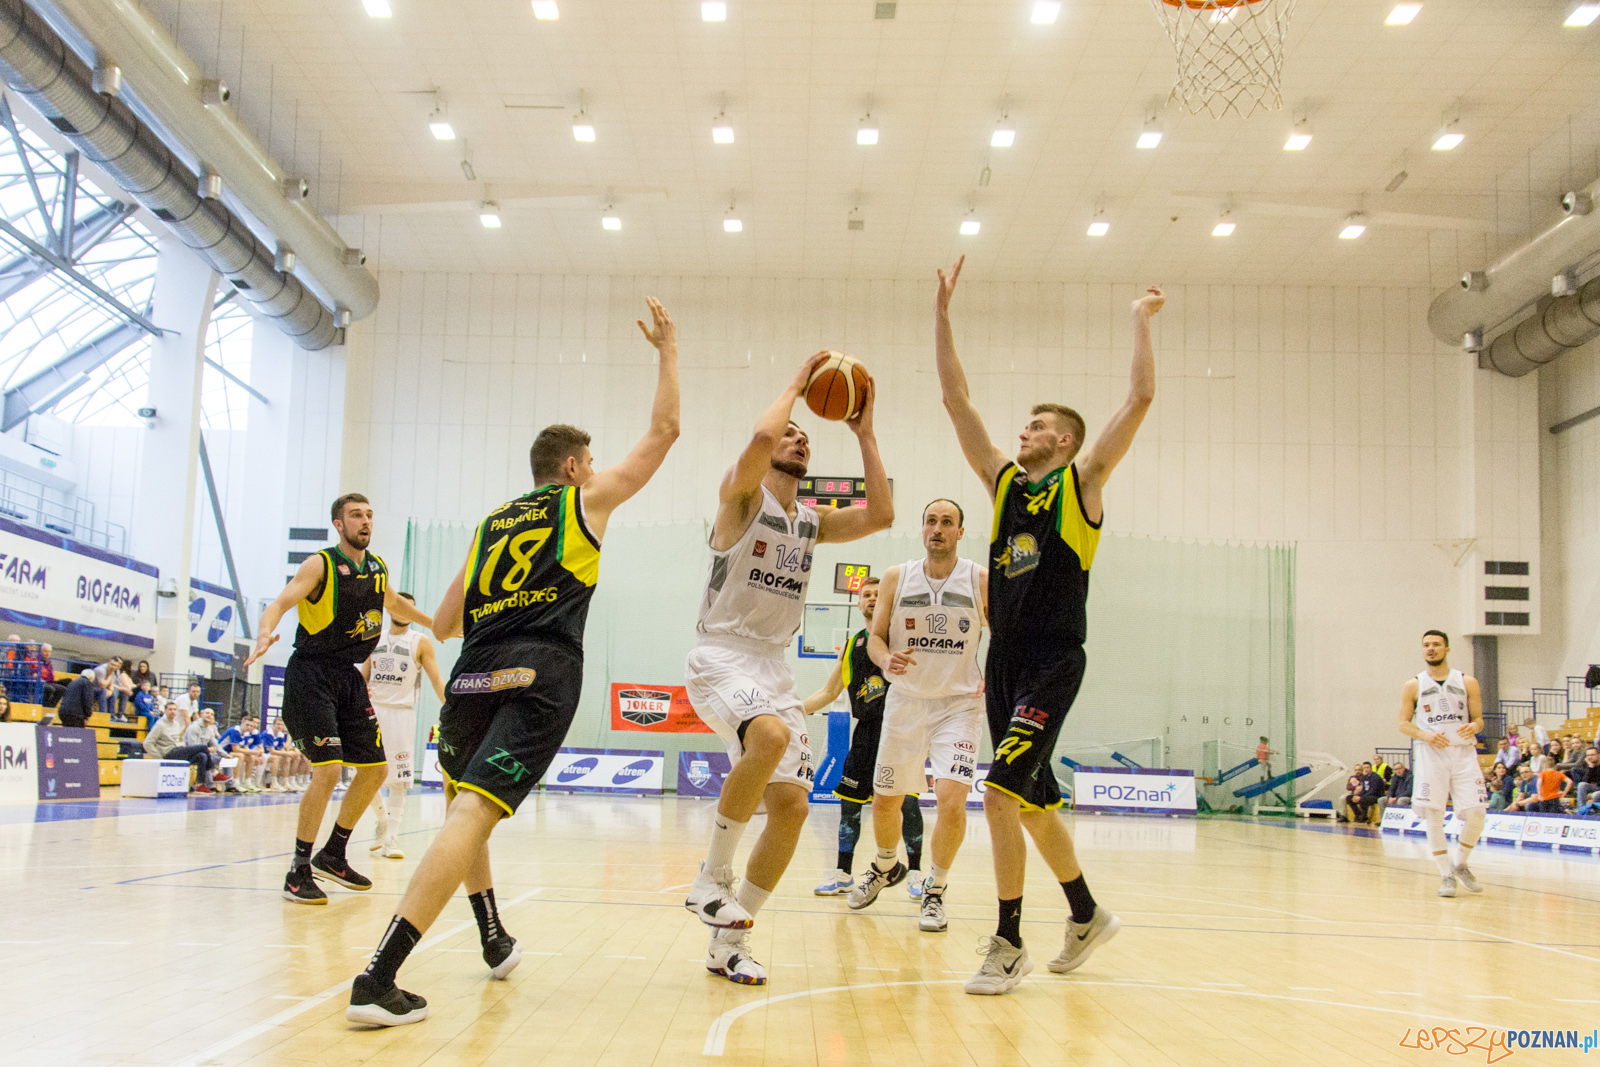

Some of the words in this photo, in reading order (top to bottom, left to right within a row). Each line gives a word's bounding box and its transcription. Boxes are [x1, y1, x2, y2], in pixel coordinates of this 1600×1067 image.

[831, 498, 838, 508] 3
[1026, 482, 1060, 515] 41
[479, 527, 553, 597] 18
[775, 544, 801, 572] 14
[373, 572, 386, 594] 11
[847, 576, 862, 590] 13
[76, 575, 141, 613] BIOFARM
[925, 613, 947, 634] 12
[907, 637, 964, 650] BIOFARM
[627, 700, 664, 711] JOKER
[1202, 716, 1209, 724] B
[1224, 717, 1231, 725] C
[1245, 718, 1254, 726] D
[995, 736, 1033, 765] 41
[1165, 746, 1171, 754] 2
[563, 765, 591, 775] atrem
[618, 767, 645, 777] atrem
[877, 763, 895, 785] 12
[958, 765, 974, 778] PBG
[1570, 828, 1597, 840] NICKEL
